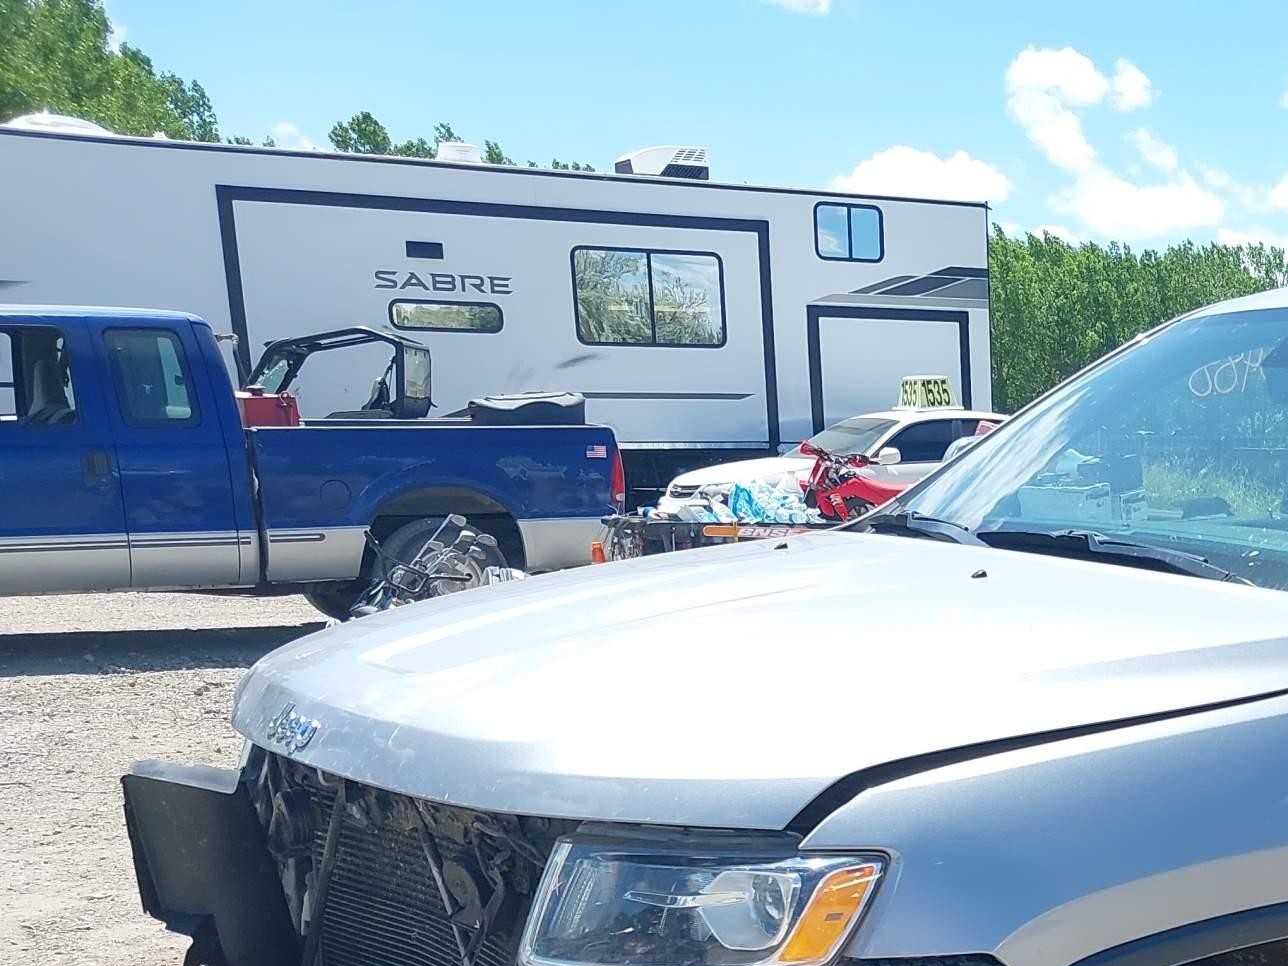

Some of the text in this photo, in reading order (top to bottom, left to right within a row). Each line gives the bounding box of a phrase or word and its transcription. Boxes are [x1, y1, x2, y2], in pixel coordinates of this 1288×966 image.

[374, 270, 513, 295] SABRE
[901, 380, 918, 407] 1535
[921, 379, 951, 407] 1535
